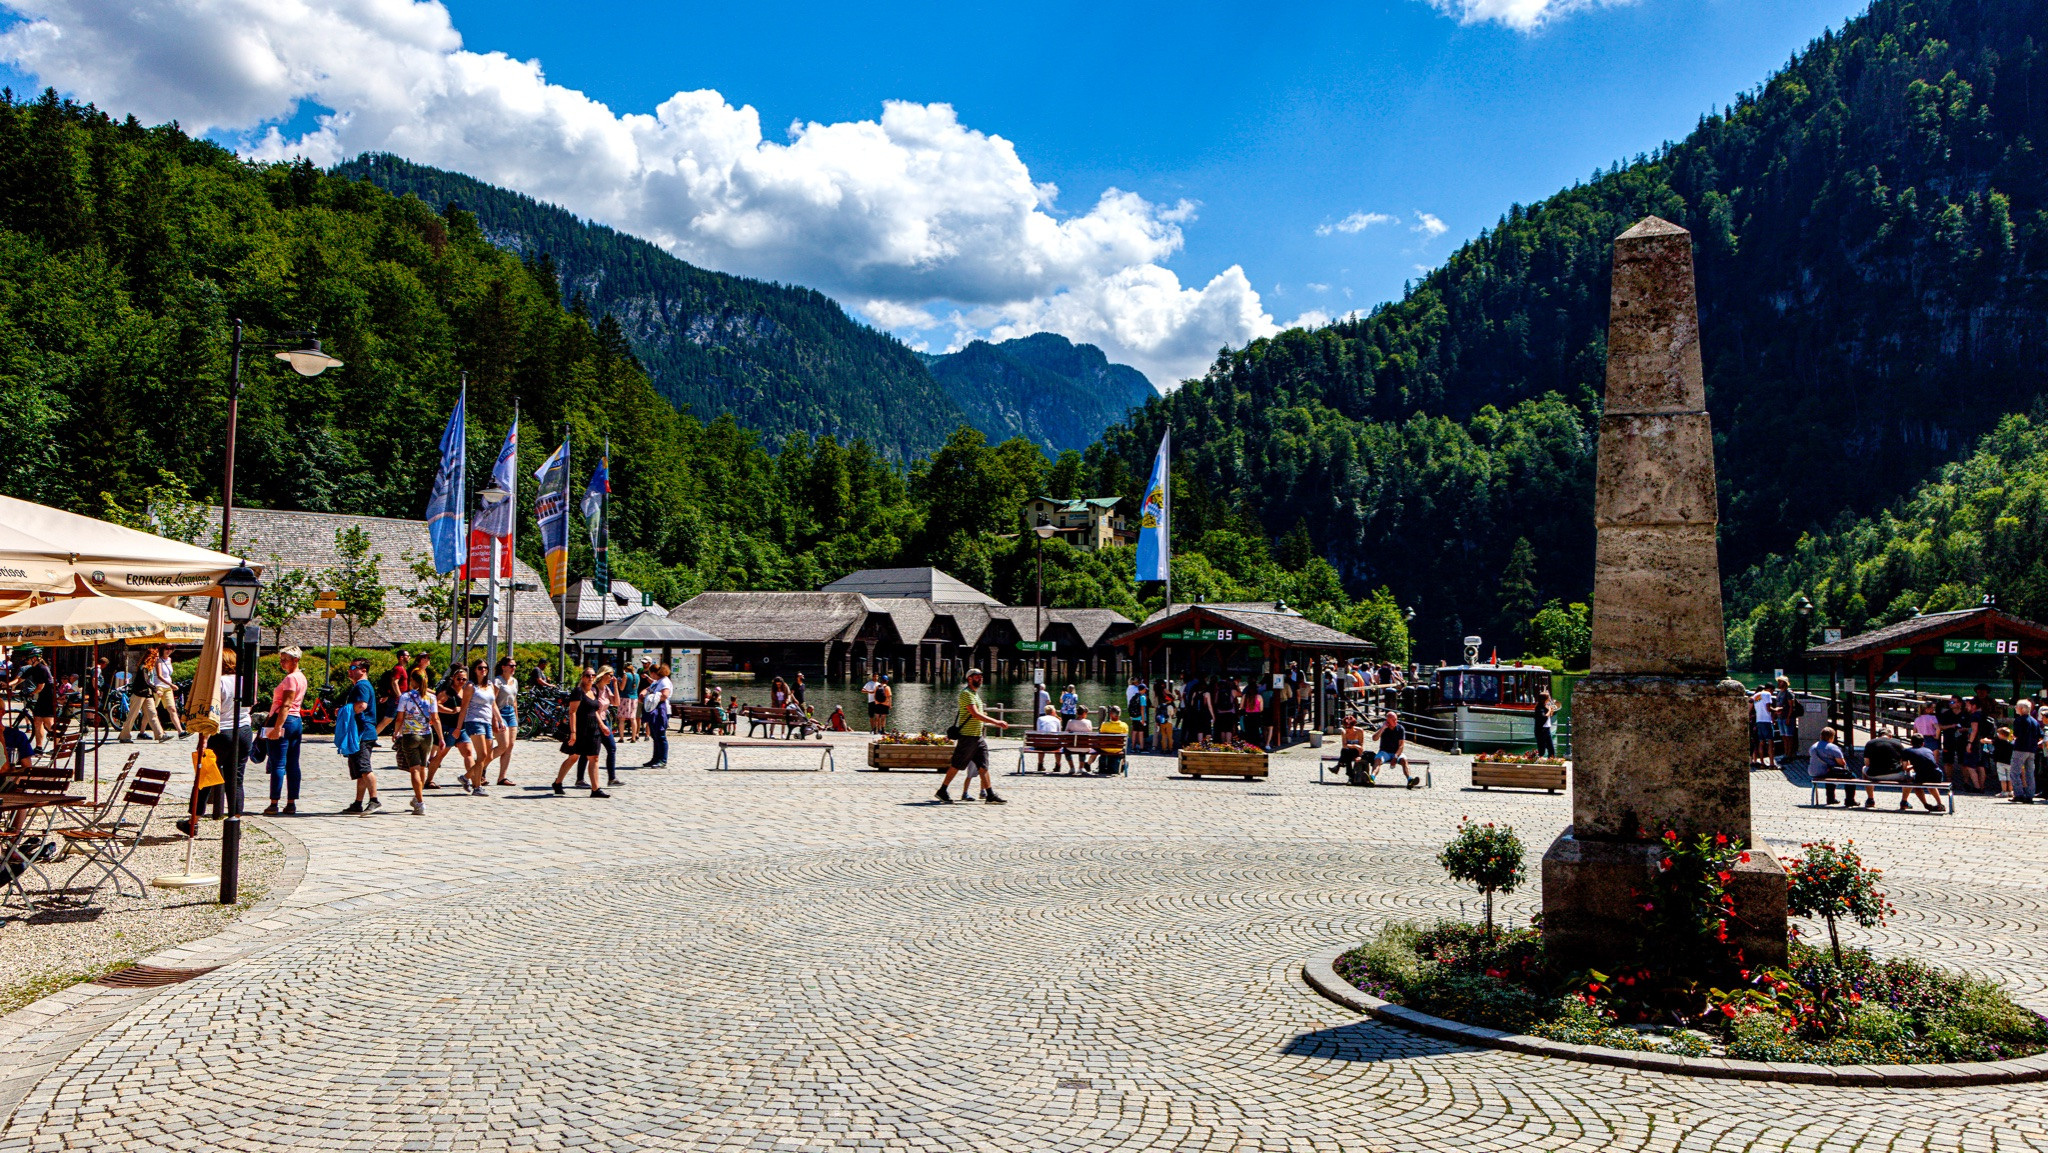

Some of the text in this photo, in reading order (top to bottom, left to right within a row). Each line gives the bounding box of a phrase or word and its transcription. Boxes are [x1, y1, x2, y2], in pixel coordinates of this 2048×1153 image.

[126, 573, 173, 587] ERDINGER
[81, 628, 116, 636] ERDINGER
[1217, 629, 1233, 640] 85
[1962, 641, 1970, 652] 2
[1996, 641, 2018, 654] 86
